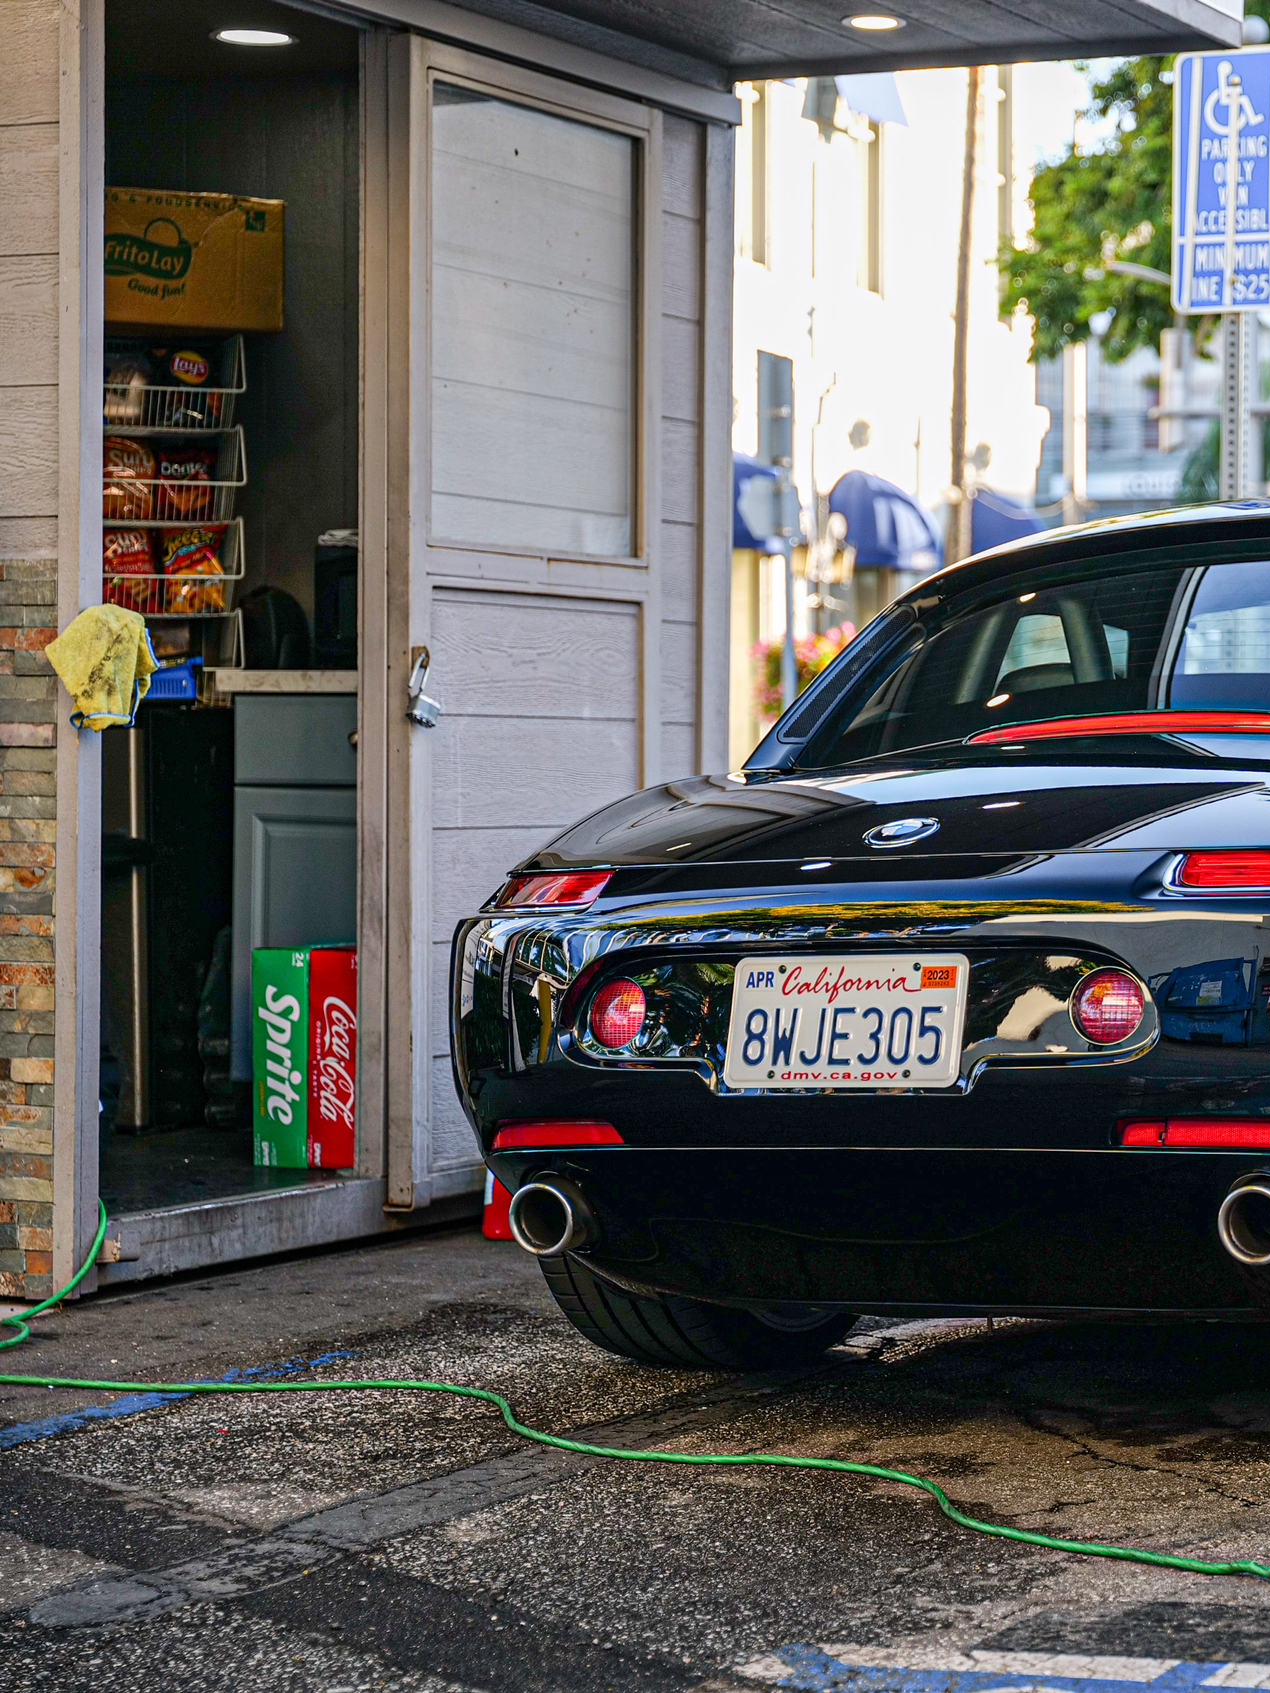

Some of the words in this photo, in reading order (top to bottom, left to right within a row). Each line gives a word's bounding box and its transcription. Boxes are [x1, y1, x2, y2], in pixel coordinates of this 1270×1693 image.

[1218, 186, 1249, 207] VN
[1196, 244, 1270, 271] MINMUM
[127, 277, 159, 297] Good
[161, 282, 187, 299] fun!
[1191, 276, 1222, 302] INE
[295, 952, 304, 967] 24
[746, 971, 775, 988] APR
[781, 965, 922, 1004] California
[927, 969, 950, 981] 2023
[742, 1006, 943, 1066] 8WJE305
[258, 984, 302, 1125] Sprite
[781, 1070, 898, 1081] dmv.ca.gov
